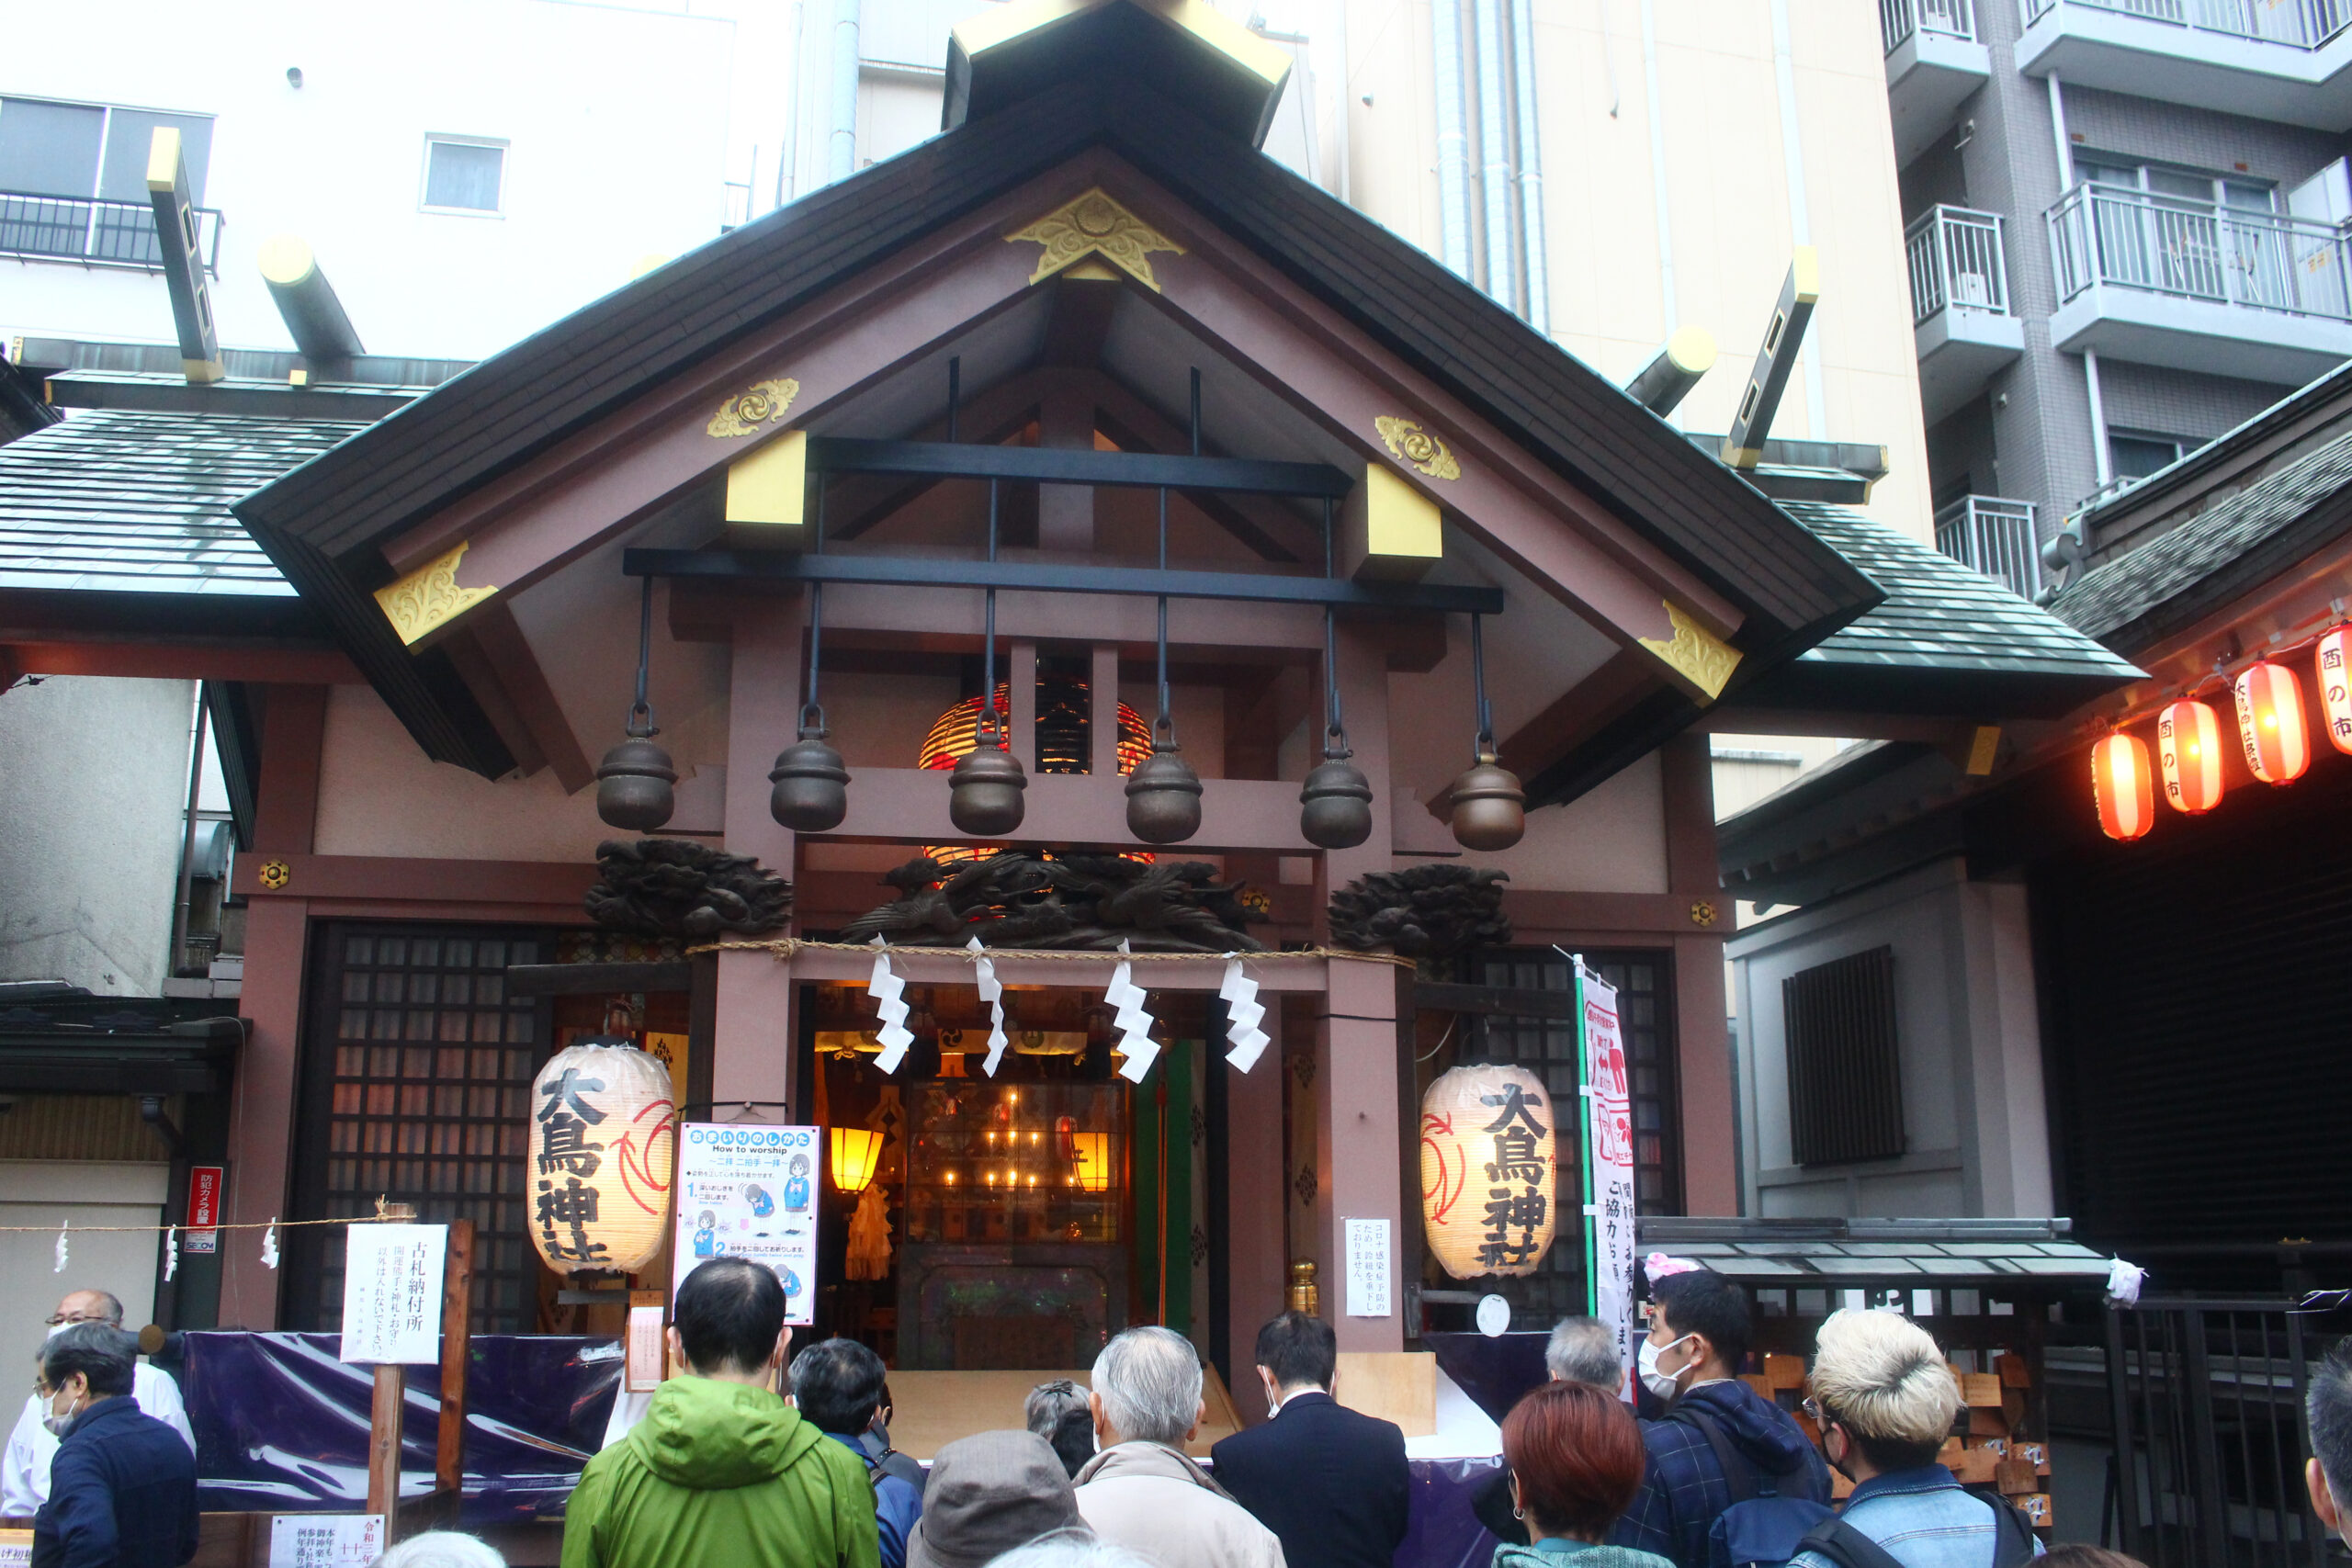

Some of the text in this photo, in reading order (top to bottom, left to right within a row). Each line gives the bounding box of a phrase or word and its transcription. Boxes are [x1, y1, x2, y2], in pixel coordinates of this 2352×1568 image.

[2323, 648, 2352, 738] 酉の市
[2160, 720, 2179, 797] 酉の市
[537, 1067, 612, 1262] 大鳥神社
[691, 1130, 809, 1146] おまいりのしかた
[712, 1145, 787, 1156] How to worship
[197, 1175, 213, 1224] 防犯カメラ設置
[1473, 1083, 1547, 1268] 大鳥神社
[187, 1242, 214, 1250] SECOM
[406, 1241, 427, 1332] 古札納付所
[363, 1521, 375, 1568] 令和三年
